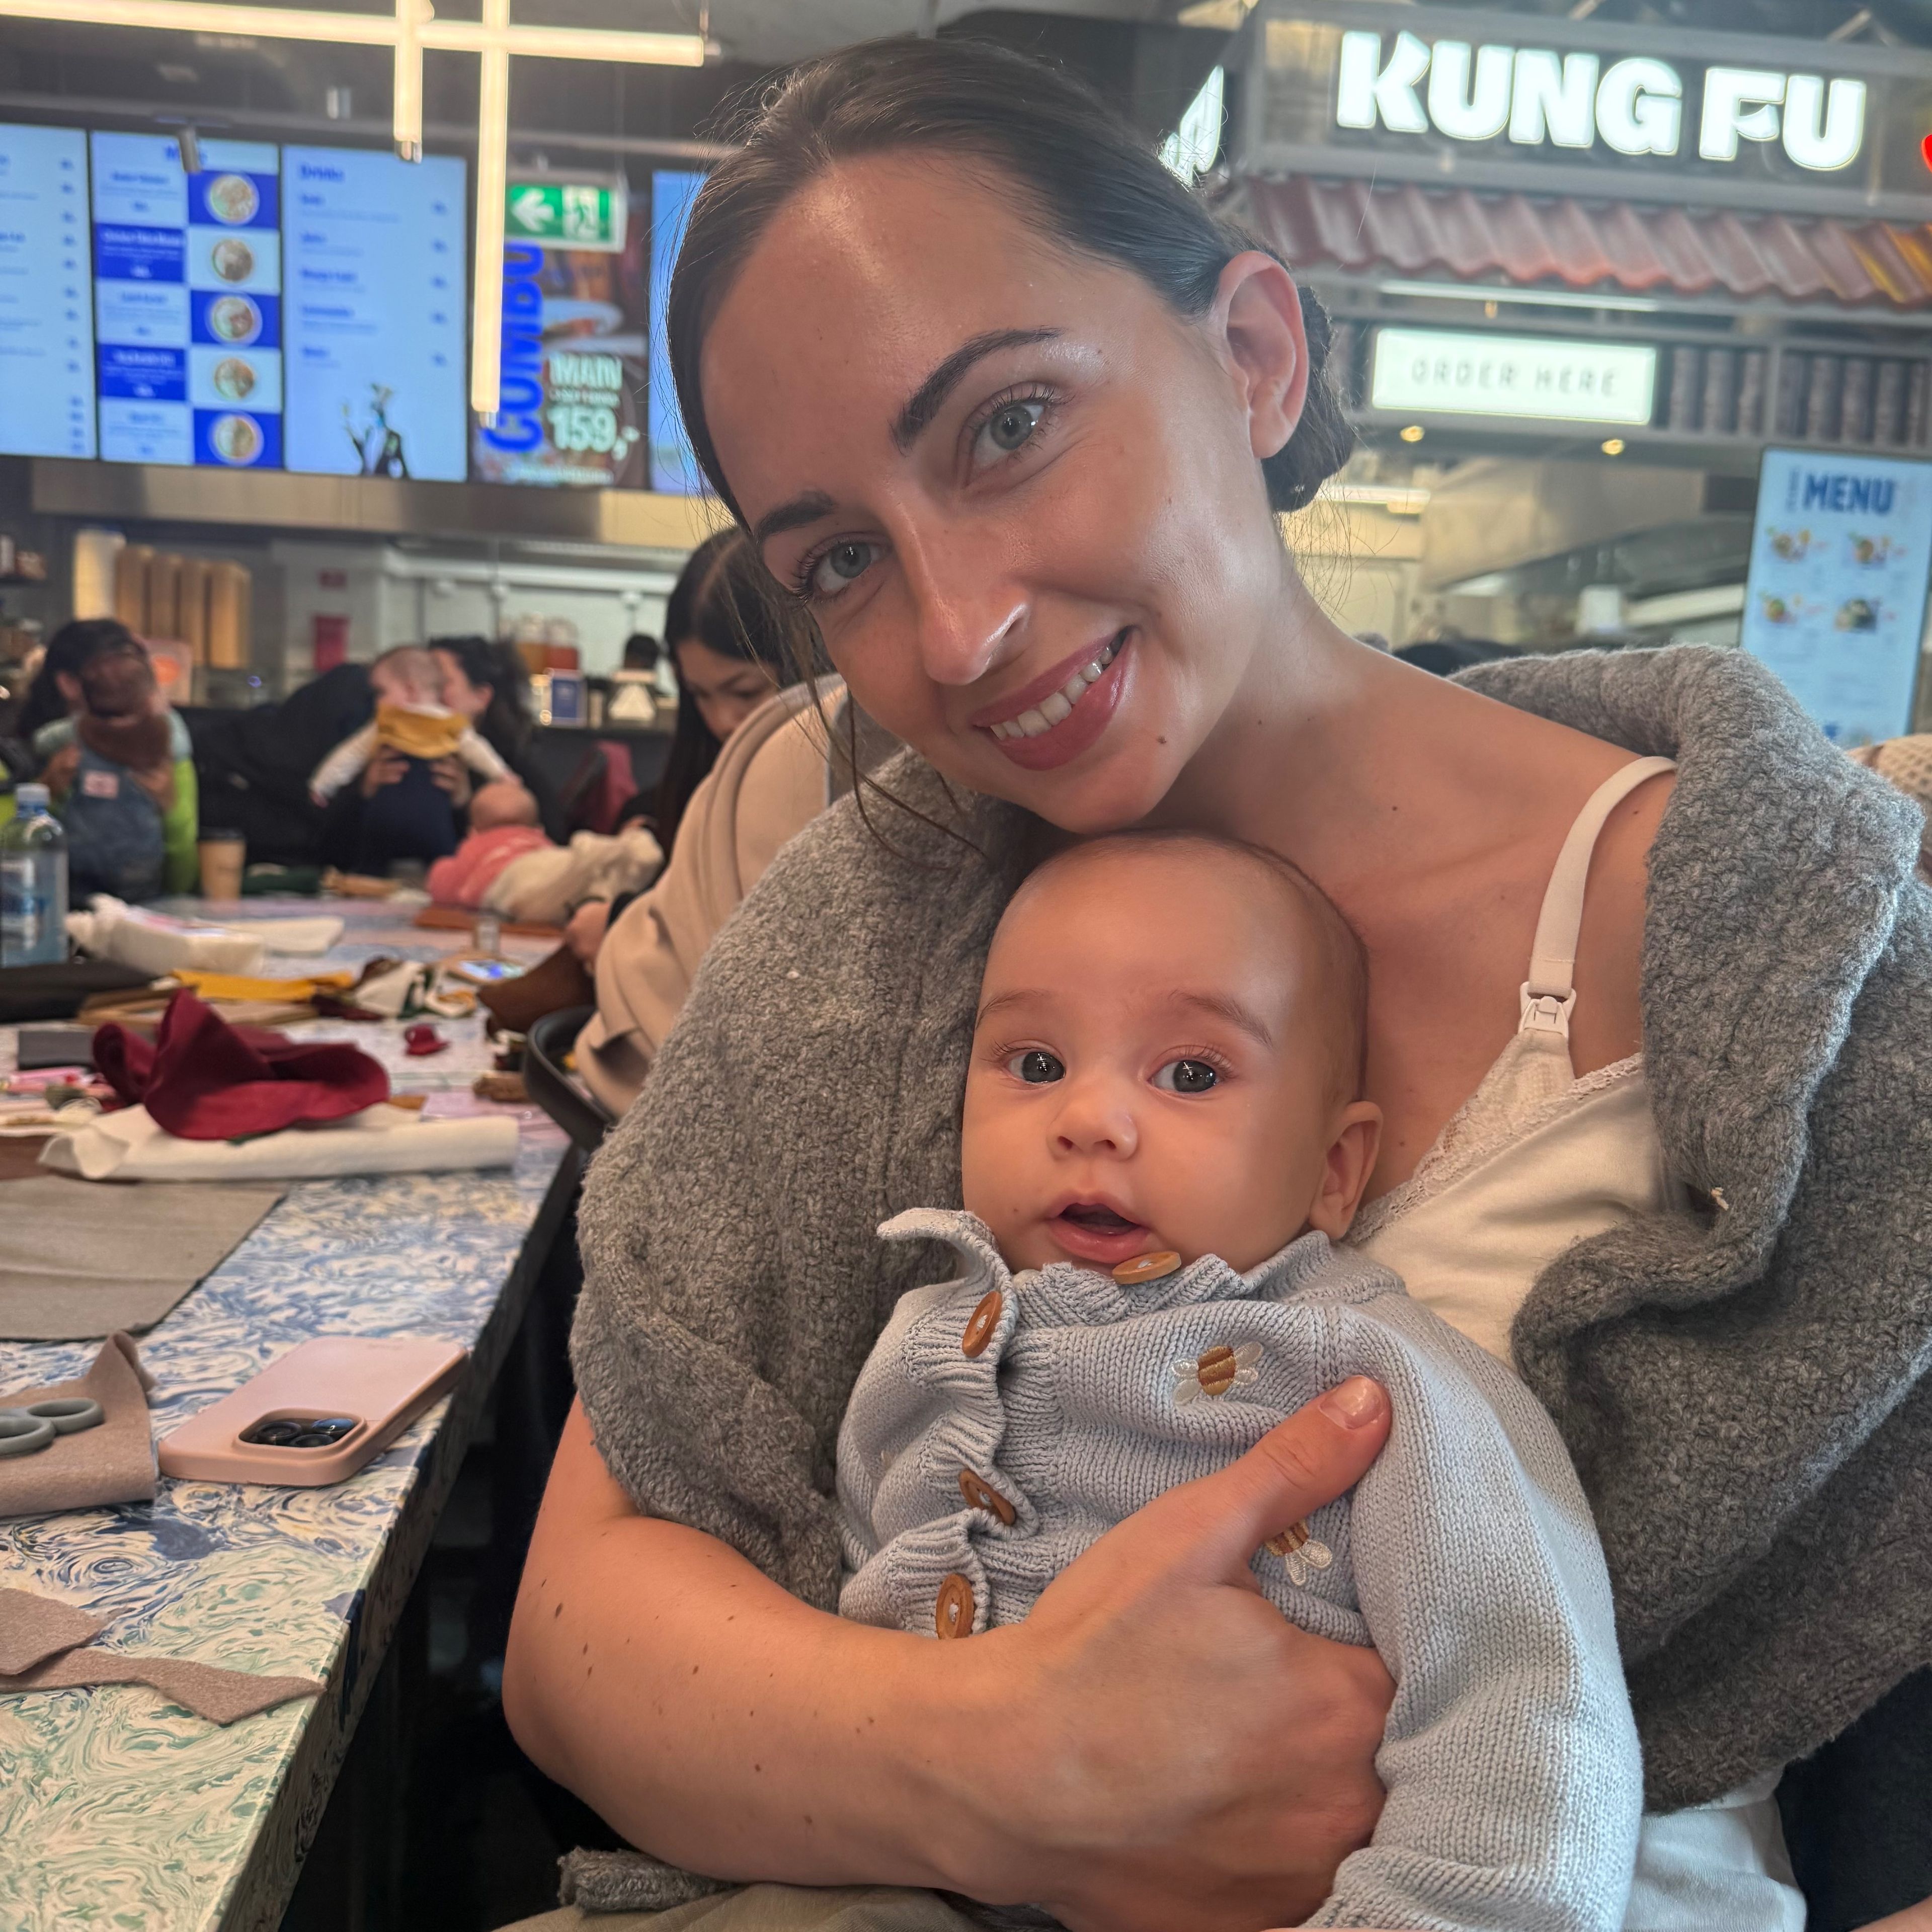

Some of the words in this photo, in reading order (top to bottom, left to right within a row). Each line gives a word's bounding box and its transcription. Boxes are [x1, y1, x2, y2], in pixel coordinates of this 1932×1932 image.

[1336, 29, 1682, 156] KUNG
[1699, 66, 1867, 172] FU
[549, 353, 622, 391] MAIN
[1411, 355, 1519, 391] ORDER
[1535, 365, 1620, 398] HERE
[1803, 474, 1896, 517] MENU
